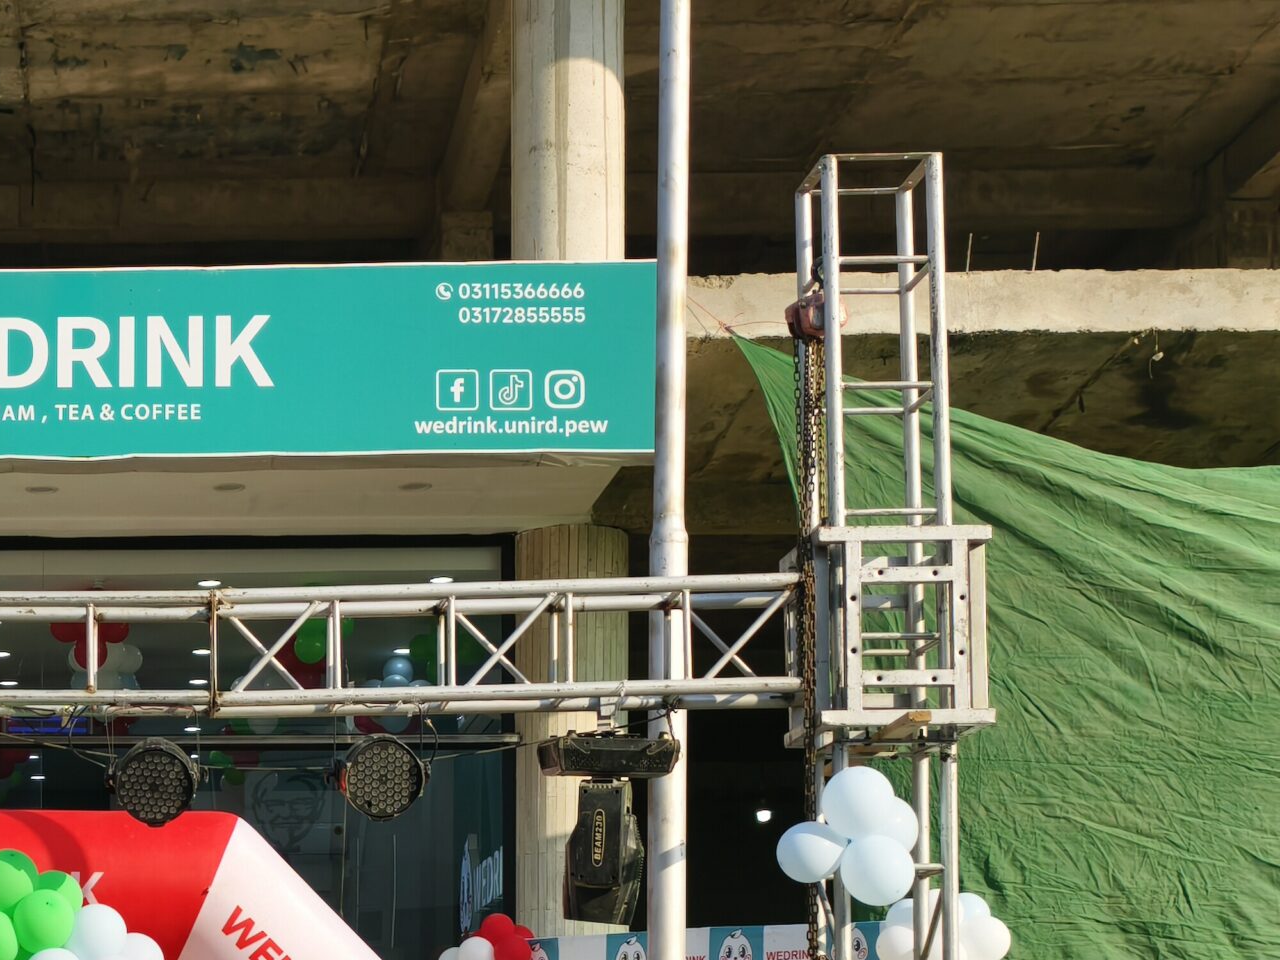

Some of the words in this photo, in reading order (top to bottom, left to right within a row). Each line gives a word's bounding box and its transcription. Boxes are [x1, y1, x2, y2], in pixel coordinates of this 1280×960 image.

[458, 282, 585, 299] 03115366666
[458, 306, 586, 324] 03172855555
[54, 404, 95, 421] TEA
[99, 403, 115, 421] &
[120, 403, 202, 420] COFFEE
[415, 415, 609, 436] wedrink.unird.pew
